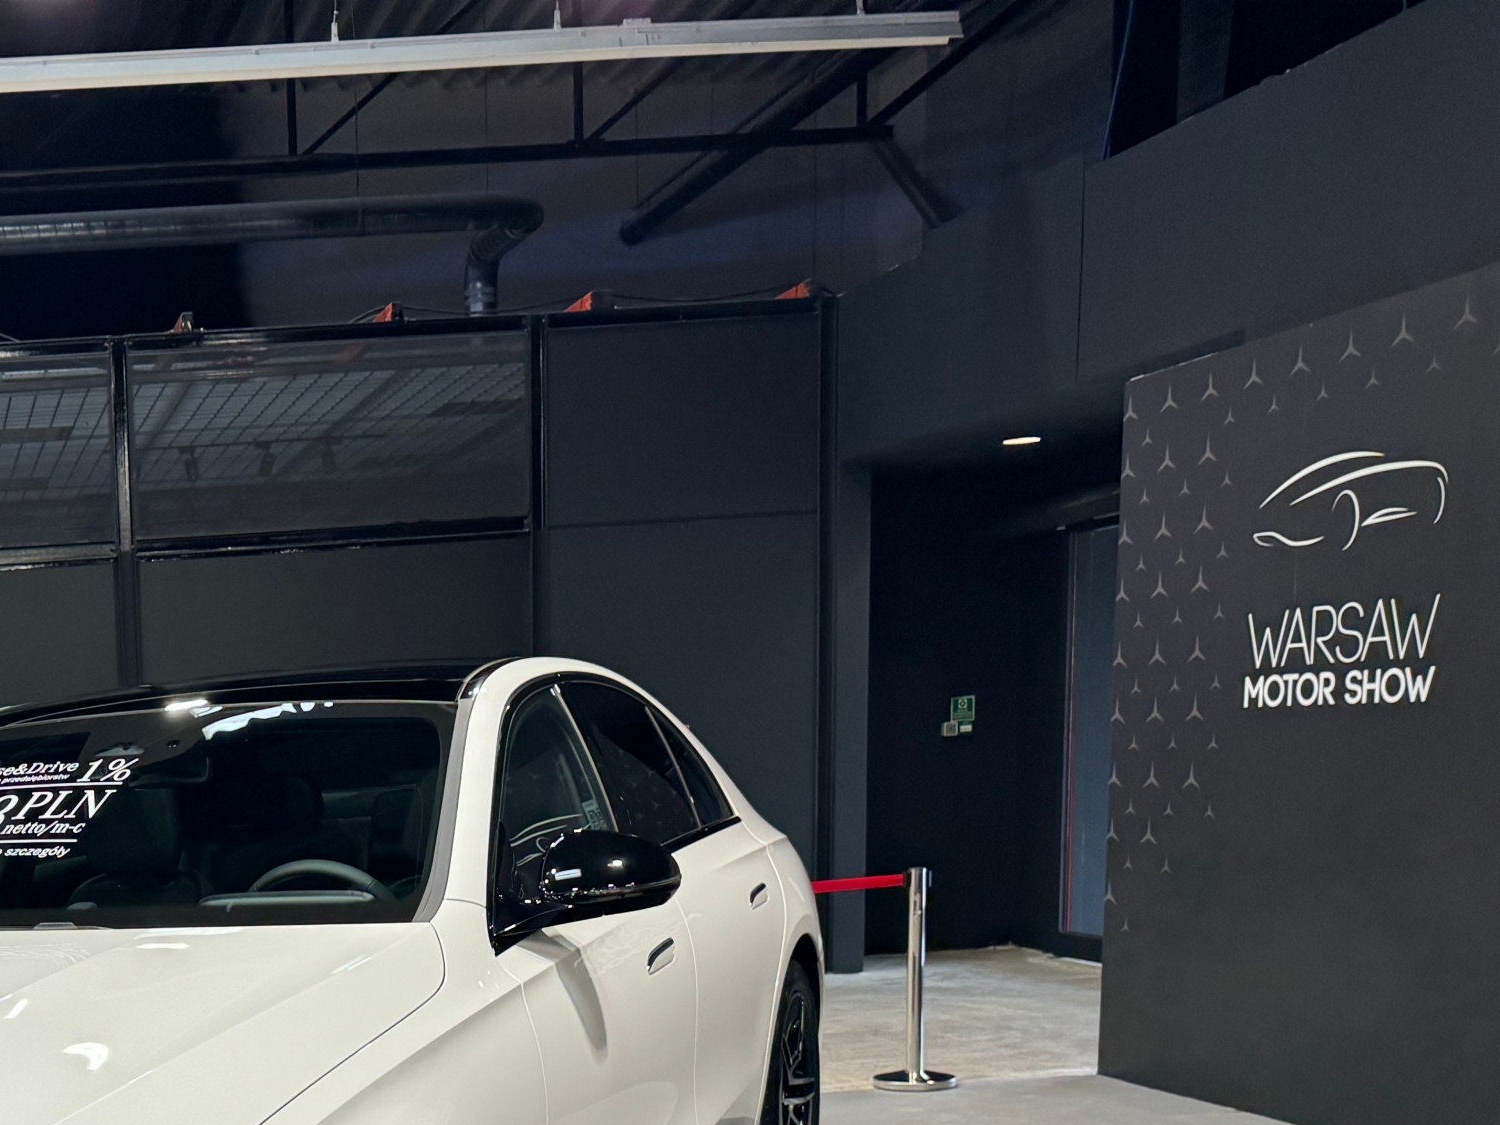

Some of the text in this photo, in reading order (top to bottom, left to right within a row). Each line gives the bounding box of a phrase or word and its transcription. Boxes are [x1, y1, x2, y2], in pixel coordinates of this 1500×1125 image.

[1248, 593, 1441, 670] WARSAW
[1243, 665, 1436, 709] MOTOR SHOW
[76, 758, 139, 783] 1%
[11, 789, 116, 821] PLN
[0, 820, 86, 837] netto/m-c
